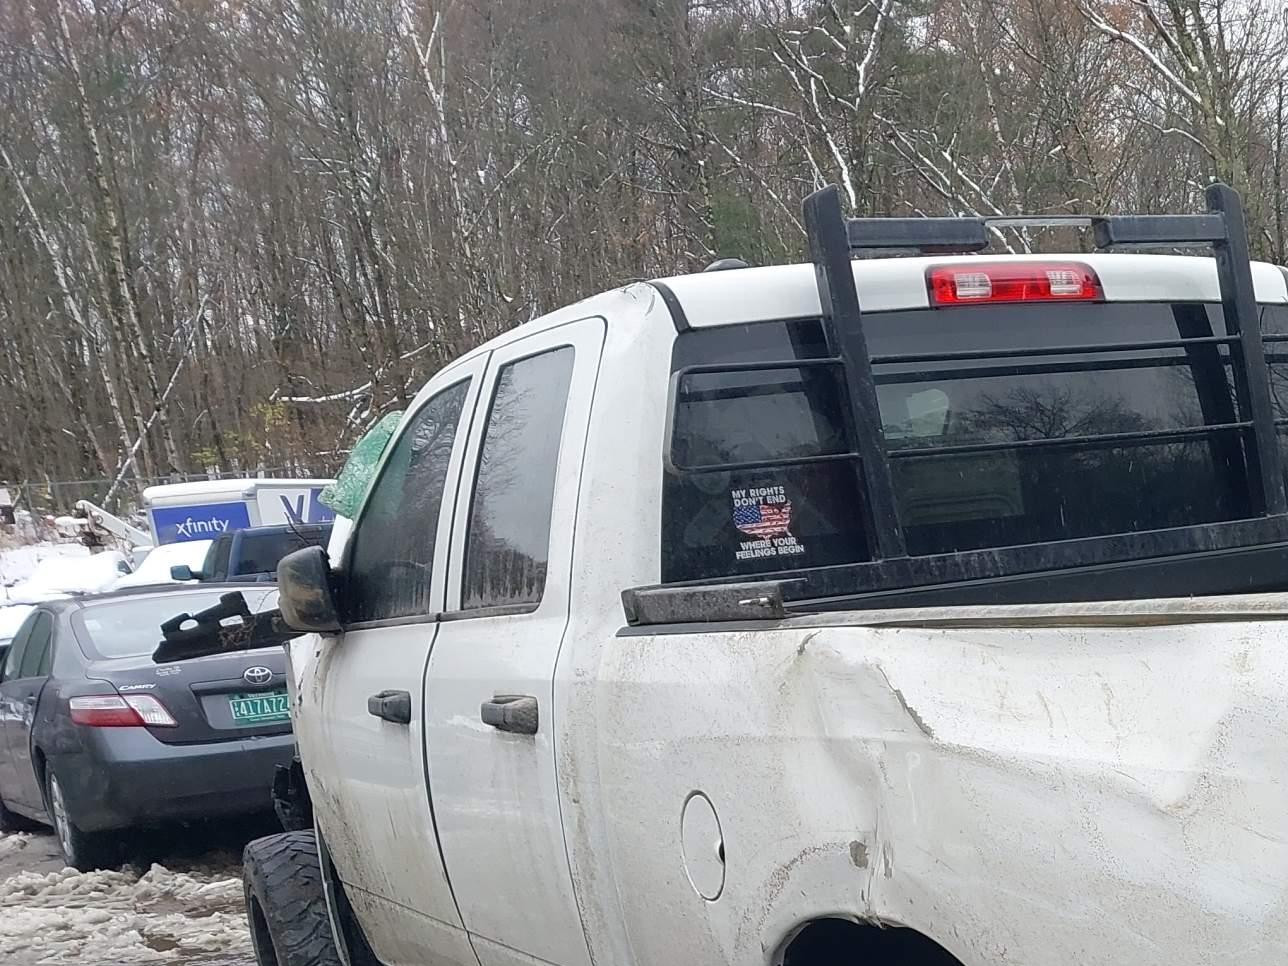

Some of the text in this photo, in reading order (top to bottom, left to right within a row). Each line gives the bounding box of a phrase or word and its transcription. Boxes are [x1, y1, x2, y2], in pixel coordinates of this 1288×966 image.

[731, 486, 785, 499] MY RIGHTS
[733, 495, 786, 507] DON'T END
[175, 517, 229, 538] xfinity
[740, 537, 797, 551] WHERE YOUR
[735, 544, 805, 560] FEELINGS BEGIN
[119, 683, 157, 691] CAMRY
[240, 696, 290, 716] 417A72
